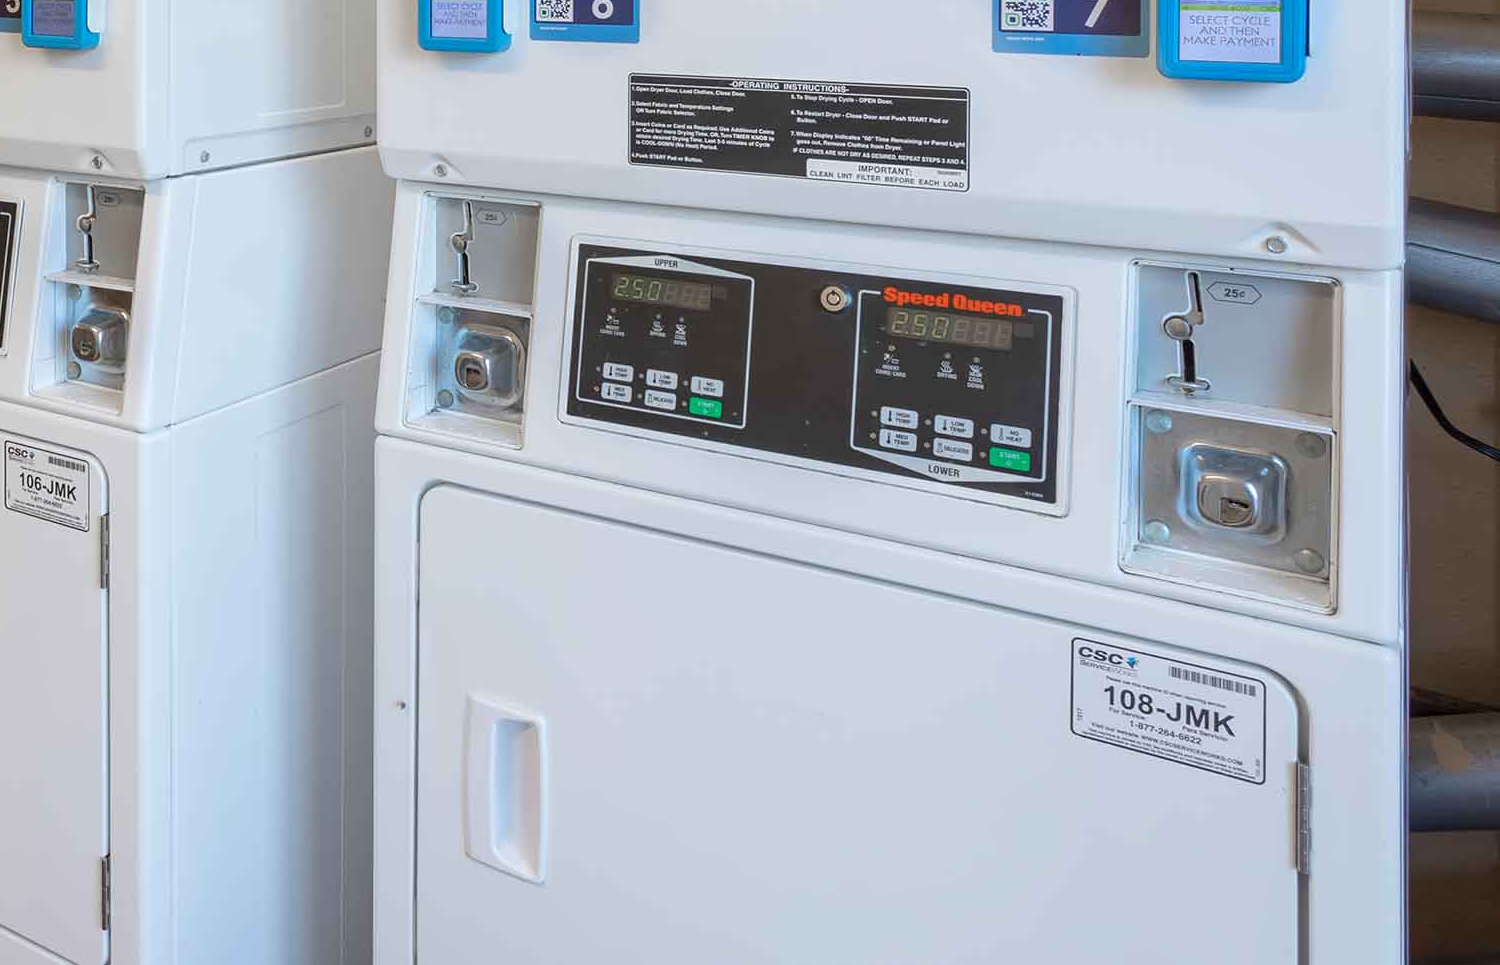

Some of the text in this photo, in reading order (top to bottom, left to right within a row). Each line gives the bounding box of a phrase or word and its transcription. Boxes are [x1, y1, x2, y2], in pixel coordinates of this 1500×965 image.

[1189, 15, 1271, 26] SELECT CYCLE
[1199, 26, 1260, 36] AND THEN
[1183, 36, 1275, 46] MAKE PAYMENT
[810, 170, 834, 178] CLEAN
[856, 173, 881, 181] FILTER
[885, 176, 914, 184] BEFORE
[919, 178, 940, 186] EACH
[654, 259, 678, 268] UPPER
[883, 287, 1023, 317] Speed Queen
[7, 447, 28, 458] CSC
[928, 465, 960, 477] LOWER
[19, 472, 77, 501] 106-JMK
[1078, 646, 1124, 665] CSC
[1104, 685, 1236, 737] 108-JMK
[1129, 720, 1202, 745] 1-877-264-6622
